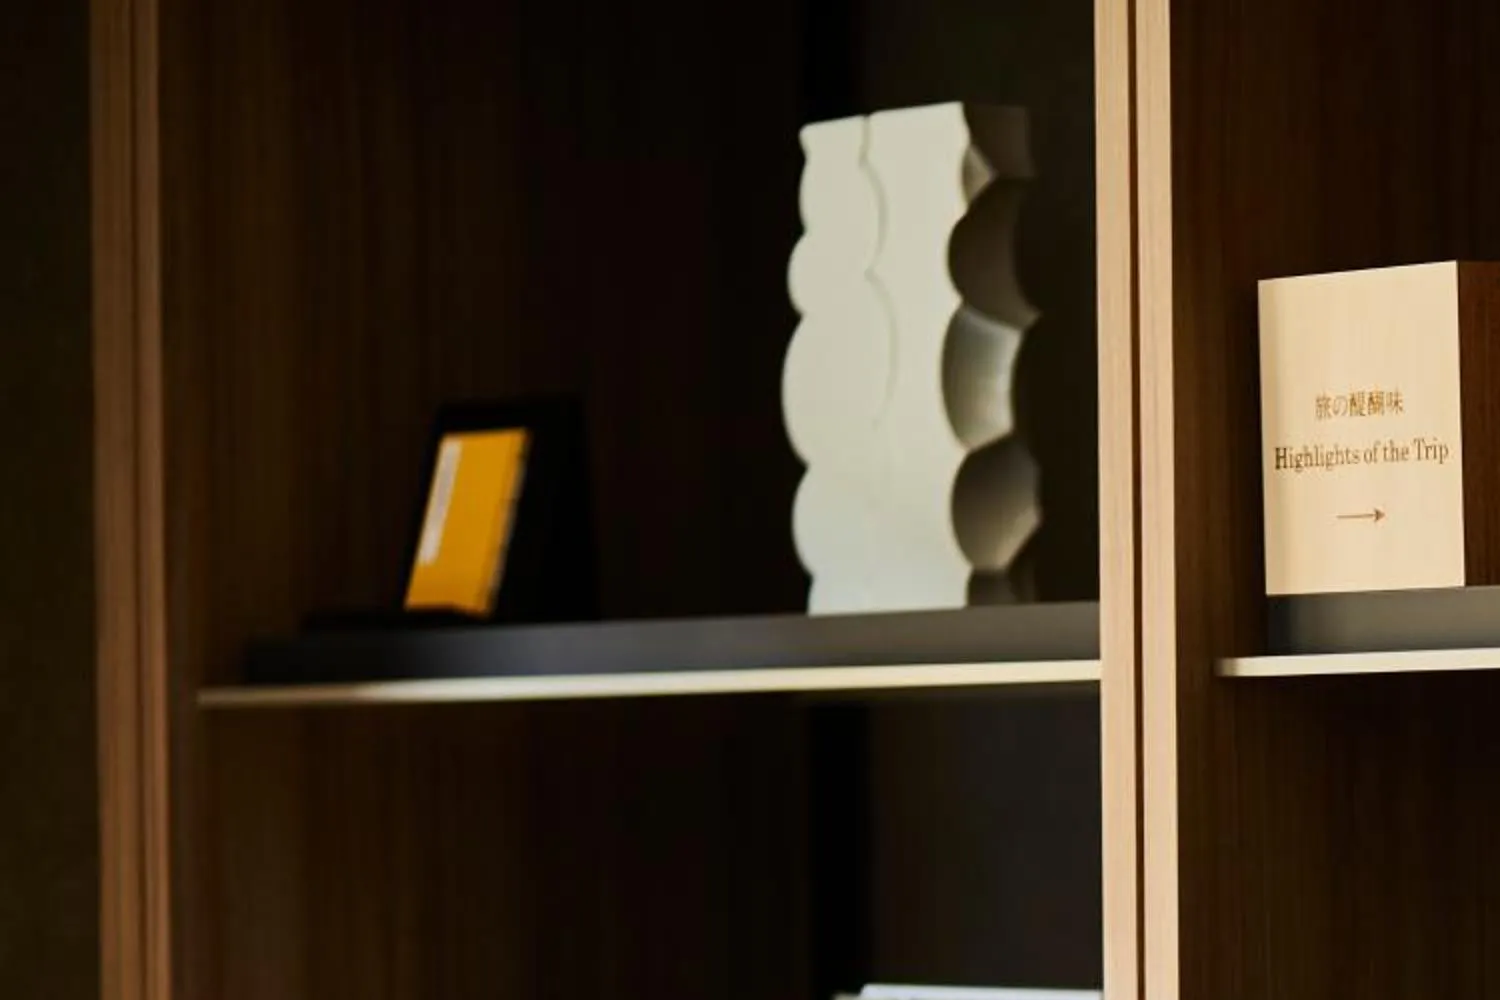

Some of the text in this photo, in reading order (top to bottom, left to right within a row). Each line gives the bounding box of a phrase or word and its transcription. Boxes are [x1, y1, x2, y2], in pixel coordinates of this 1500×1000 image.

[1315, 389, 1404, 419] 旅の醍醐味
[1275, 438, 1449, 472] Highlights of the Trip
